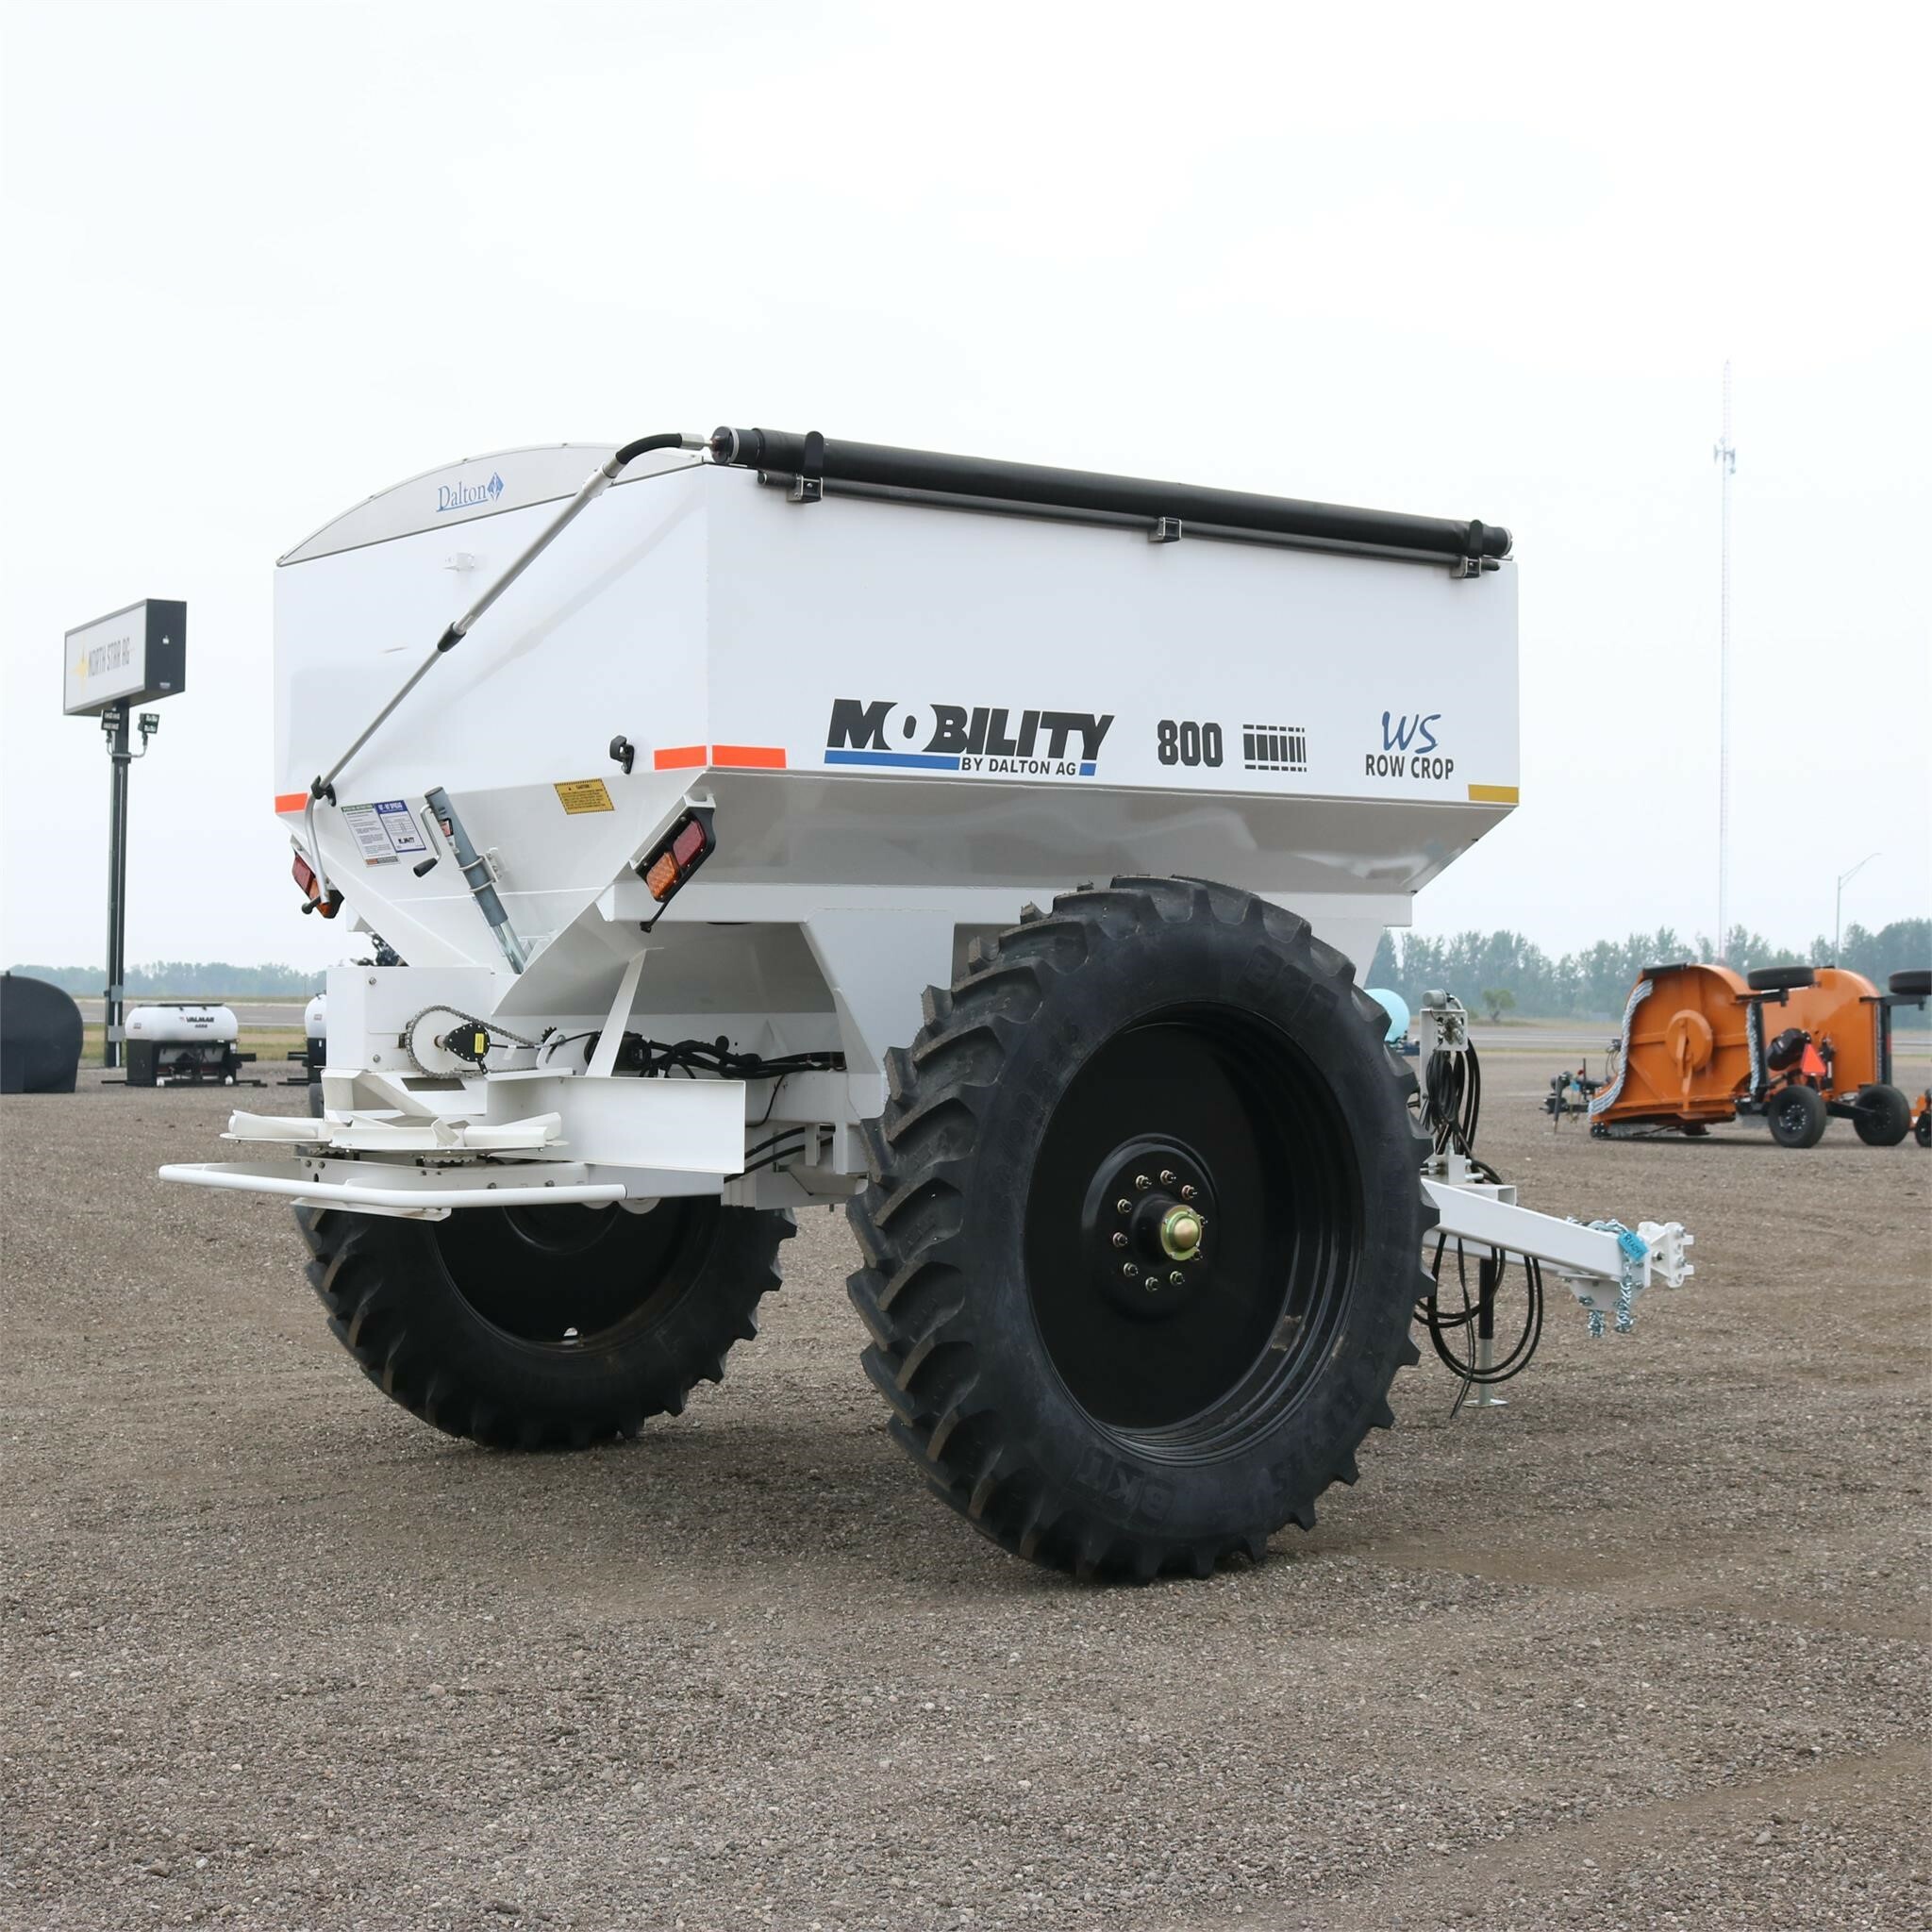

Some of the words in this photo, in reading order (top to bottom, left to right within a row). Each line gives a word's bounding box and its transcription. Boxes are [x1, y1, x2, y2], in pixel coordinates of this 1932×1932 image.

[437, 481, 488, 510] Dalton
[826, 698, 1116, 760] MOBILITY
[1157, 720, 1224, 768] 800
[1381, 710, 1442, 755] WS
[961, 757, 984, 772] BY
[989, 758, 1051, 775] DALTON
[1056, 761, 1076, 775] AG
[1365, 754, 1406, 778] ROW
[1410, 756, 1455, 781] CROP
[1074, 1453, 1173, 1524] BKT
